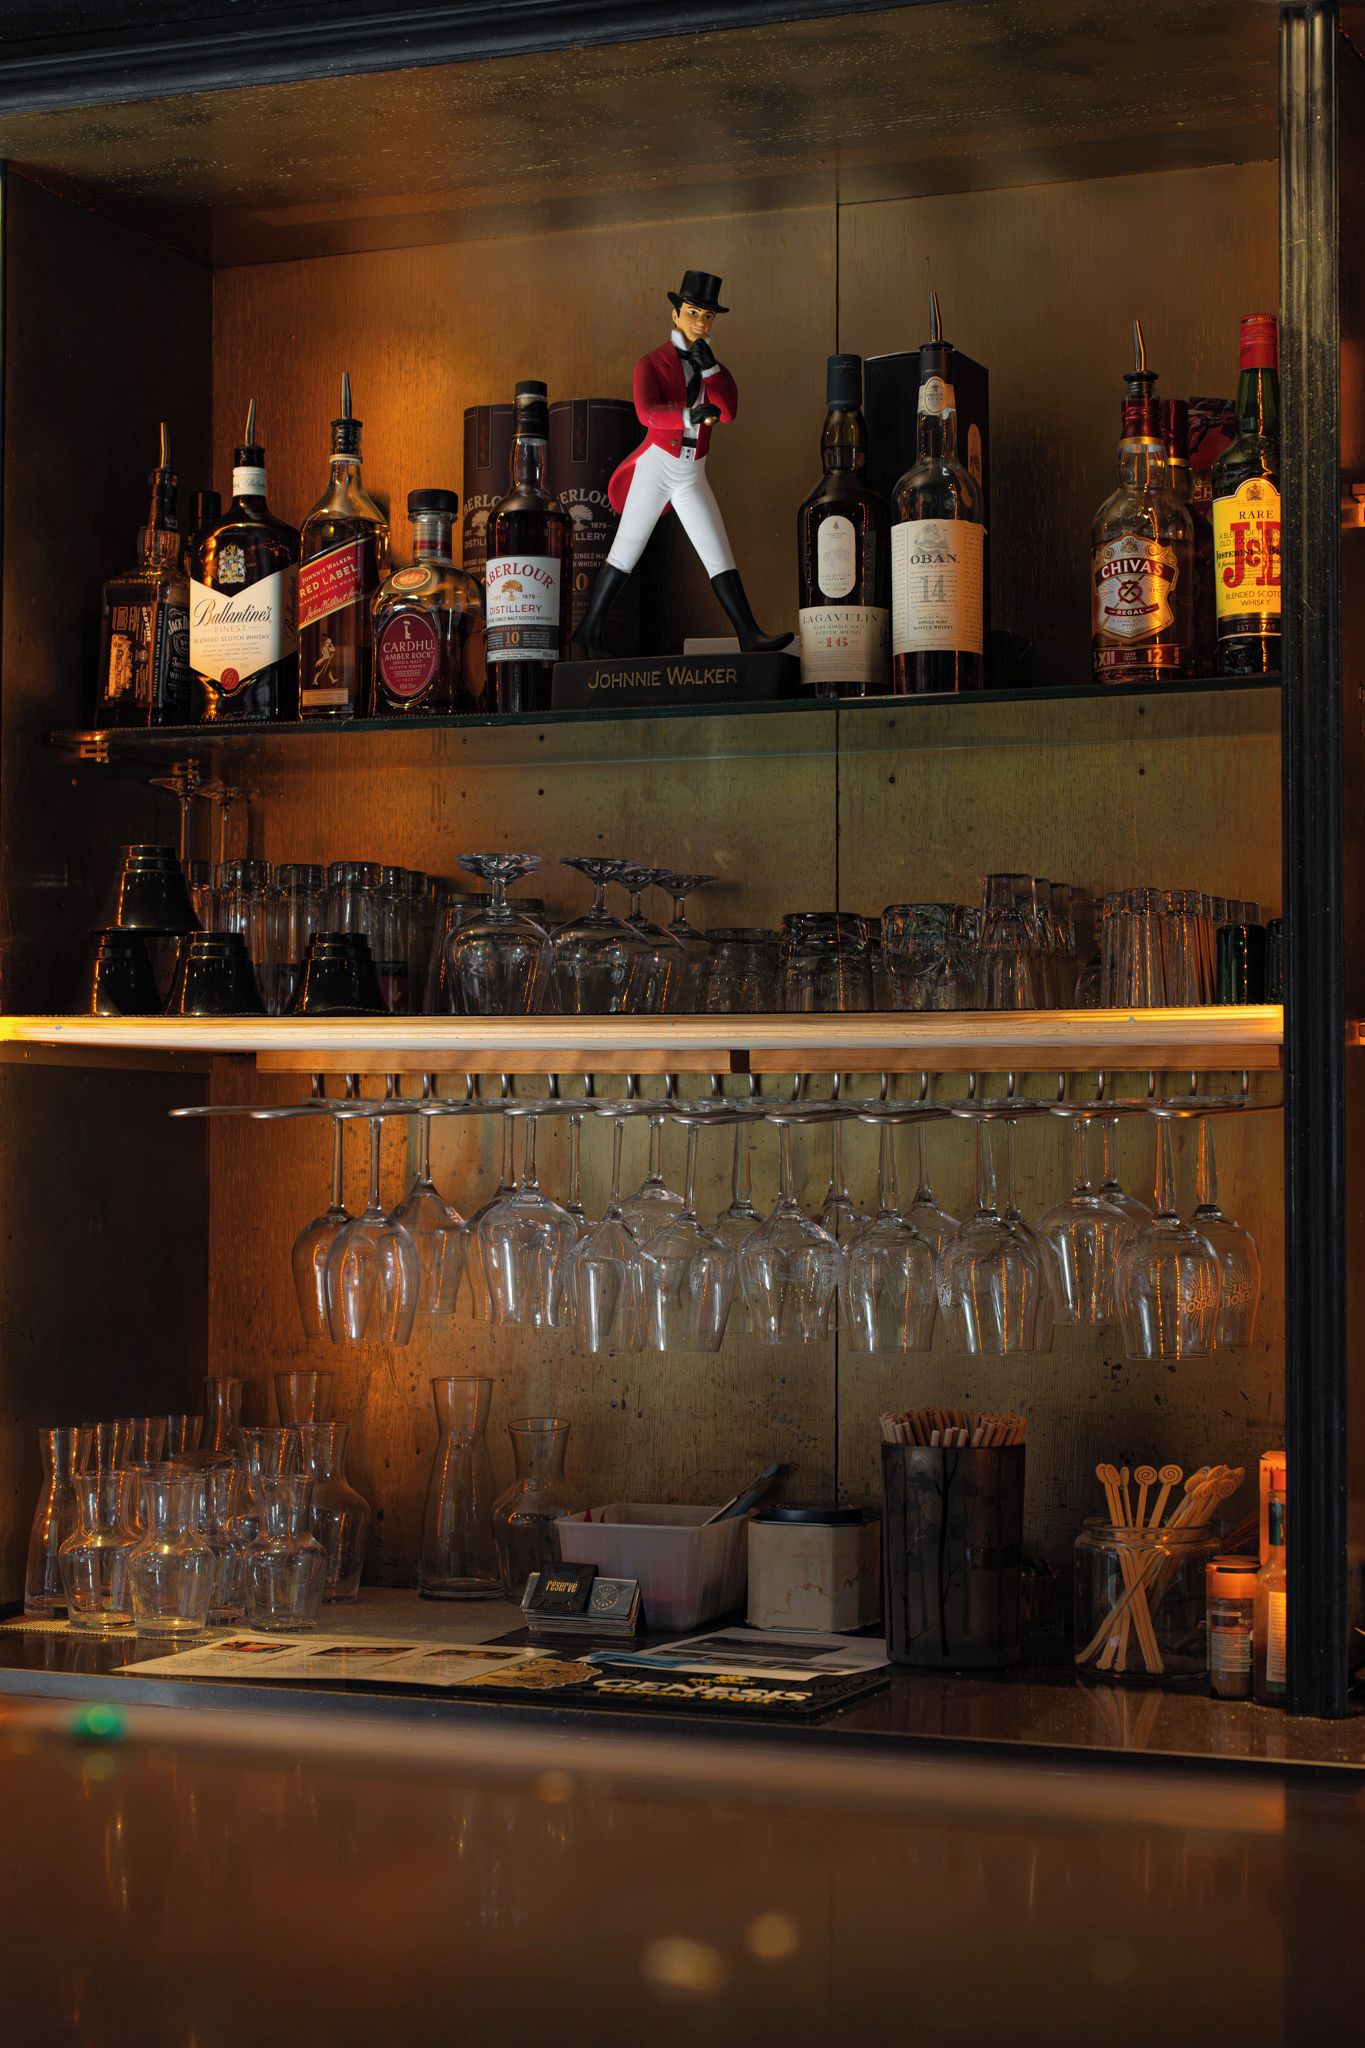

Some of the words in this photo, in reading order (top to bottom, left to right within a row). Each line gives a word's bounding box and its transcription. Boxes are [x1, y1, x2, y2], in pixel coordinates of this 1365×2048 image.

[464, 494, 504, 516] BERLO
[1239, 510, 1274, 520] RARE
[301, 568, 327, 585] JOHNNIE
[327, 555, 353, 571] WALKER
[1101, 559, 1164, 579] CHIVAS
[300, 581, 320, 598] RED
[322, 563, 360, 586] LABEL
[919, 574, 947, 603] 14
[1226, 591, 1255, 600] BLENDED
[489, 604, 542, 615] DISTILLERY
[1240, 599, 1271, 607] WHISKY
[192, 599, 272, 628] Ballantine's
[803, 613, 878, 624] LAGAVULIN
[214, 624, 246, 633] FINEST
[193, 636, 220, 644] BLENDED
[504, 631, 520, 645] 10
[826, 637, 848, 648] 16
[383, 640, 433, 653] CARDHU
[385, 653, 410, 661] AMBER
[1147, 648, 1163, 663] 12
[588, 670, 661, 689] JOHNNIE
[667, 666, 738, 686] WALKER
[593, 1680, 814, 1702] GENESIS
